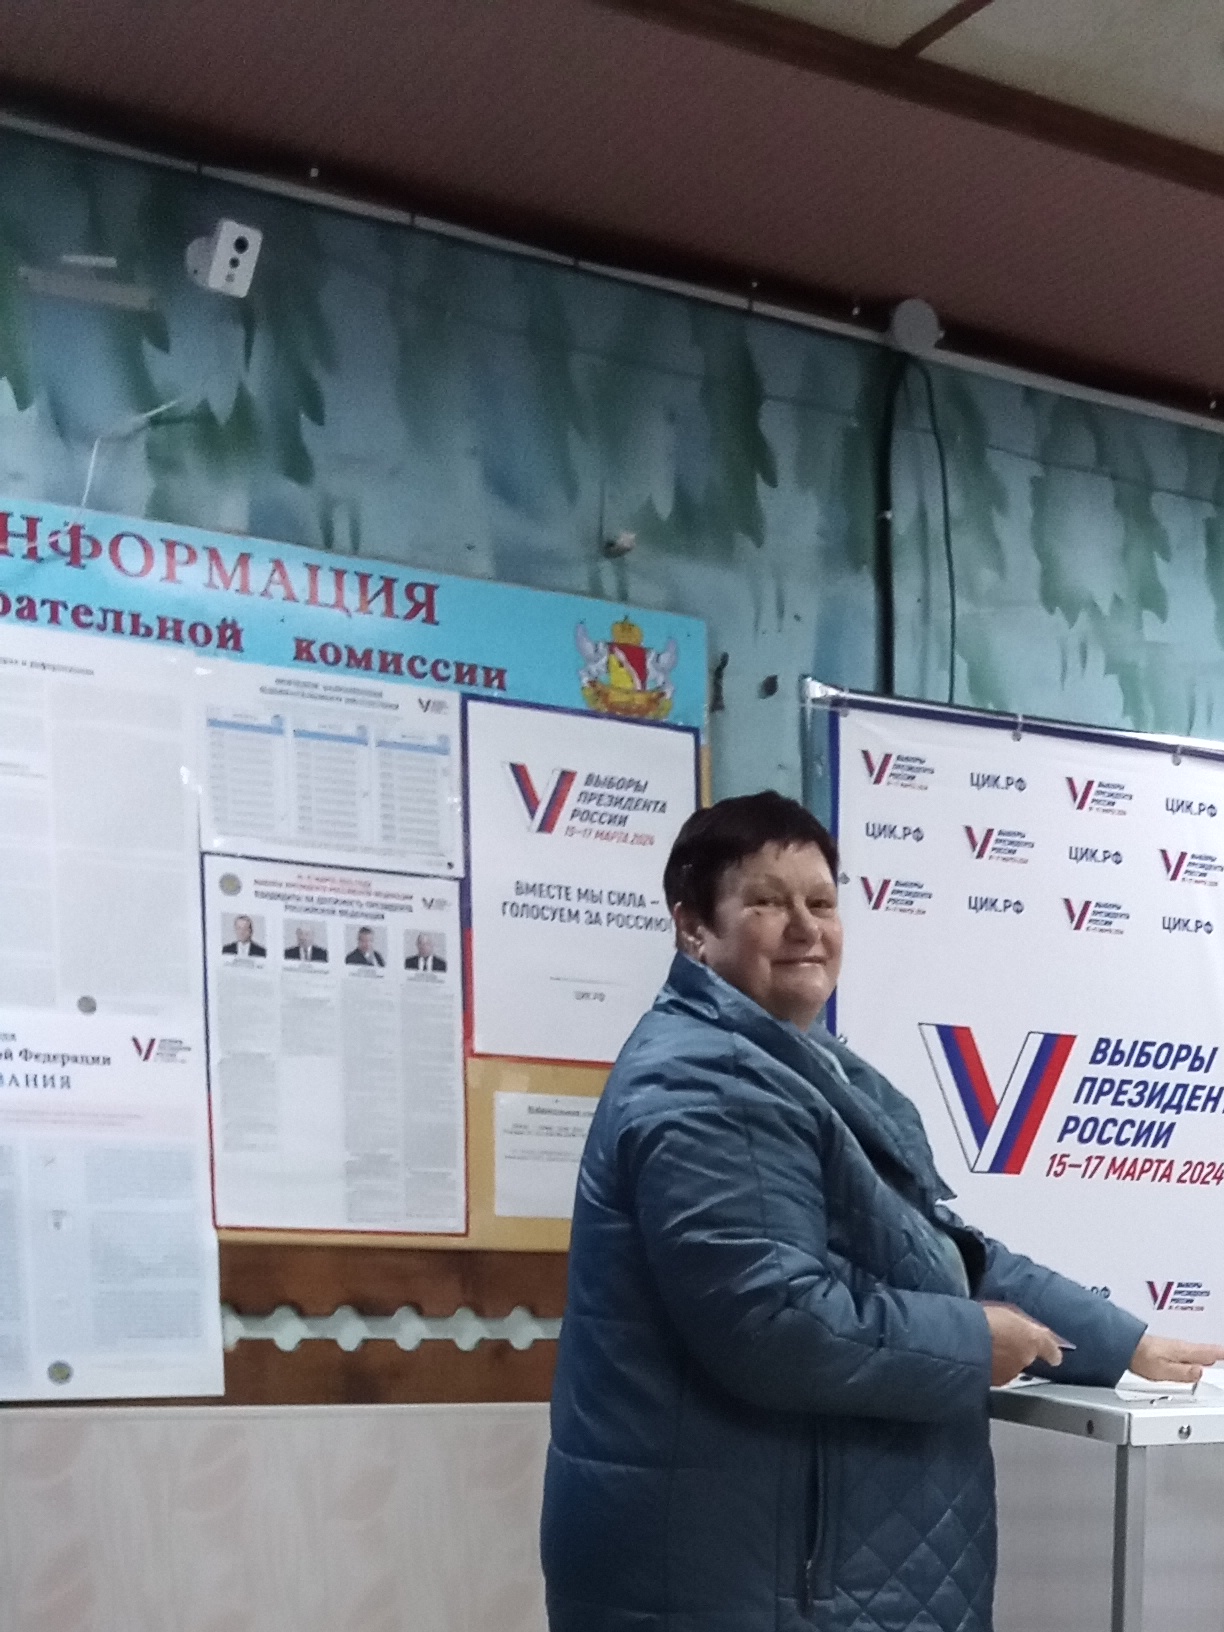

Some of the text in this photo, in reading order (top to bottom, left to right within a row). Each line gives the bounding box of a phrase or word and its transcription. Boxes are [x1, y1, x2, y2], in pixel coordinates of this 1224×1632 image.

[293, 636, 507, 691] комиссии
[584, 772, 648, 794] ВЫБОРЫ
[970, 772, 1027, 792] ЦИК.РФ
[577, 790, 667, 814] ПРЕЗИДЕНТА
[1165, 797, 1218, 818] ЦИК.РФ
[569, 808, 629, 828] РОССИИ
[865, 821, 924, 842] ЦИК.РФ
[1068, 845, 1123, 865] ЦИК.РФ
[515, 880, 572, 902] ВМЕСТЕ
[577, 886, 602, 904] МЫ
[607, 890, 647, 909] СИЛА
[967, 895, 1025, 915] ЦИК.РФ
[502, 900, 581, 925] ГОЛОСУЕМ
[1162, 915, 1214, 935] ЦИК.РФ
[1088, 1037, 1219, 1074] ВЫБОРЫ
[1056, 1115, 1177, 1149] РОССИИ
[1103, 1156, 1175, 1184] МАРТА
